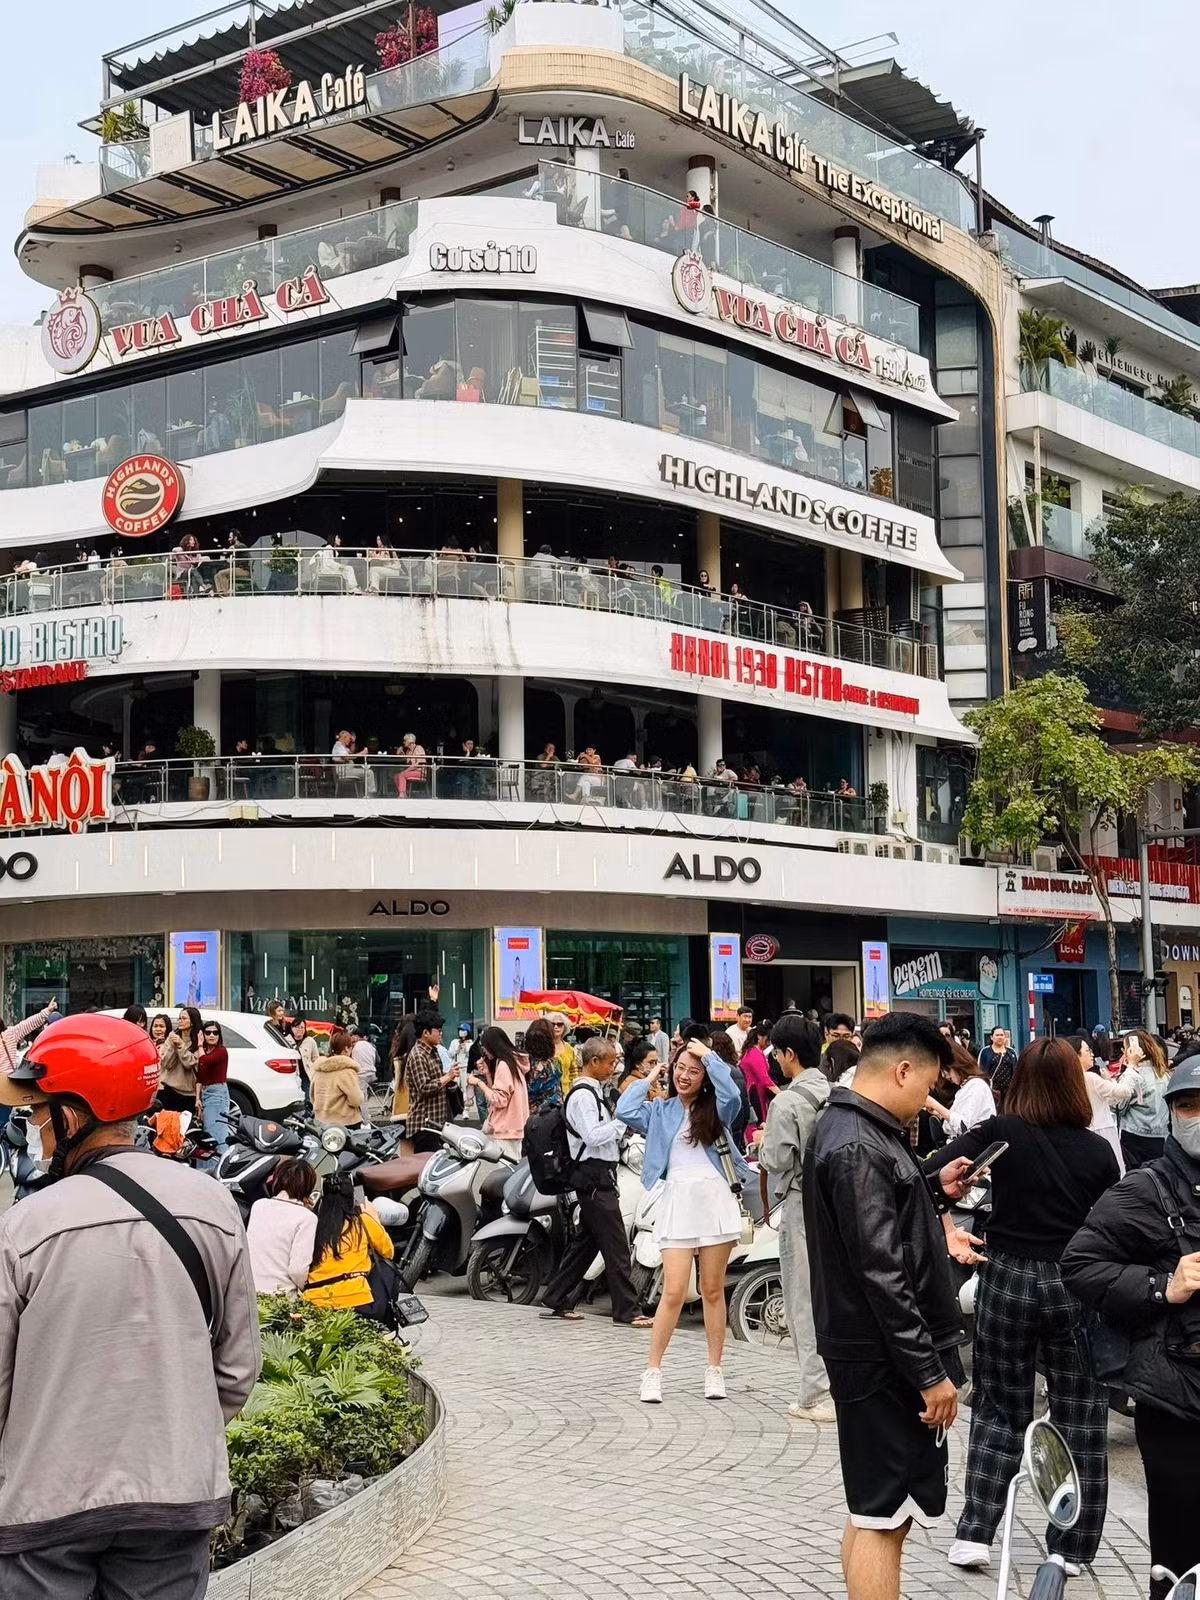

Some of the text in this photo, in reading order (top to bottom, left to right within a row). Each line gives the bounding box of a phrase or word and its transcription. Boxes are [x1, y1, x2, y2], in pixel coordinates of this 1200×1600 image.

[212, 64, 366, 150] LAIKA Café
[518, 114, 636, 149] LAIKA Café
[678, 71, 808, 173] LAIKA Café
[813, 154, 945, 243] The Exceptional
[430, 242, 464, 271] Cơ
[506, 244, 537, 273] 10
[110, 264, 330, 356] VUA CHẢ CÁ
[714, 286, 873, 373] VUA CHẢ CÁ
[105, 460, 175, 498] HIGHLANDS
[659, 454, 917, 550] HIGHLANDS COFFEE
[115, 507, 168, 531] COFFEE
[31, 615, 123, 663] BISTRO
[670, 633, 730, 680] HANOI
[735, 646, 777, 689] 1930
[662, 852, 761, 884] ALDO
[368, 900, 450, 916] ALDO
